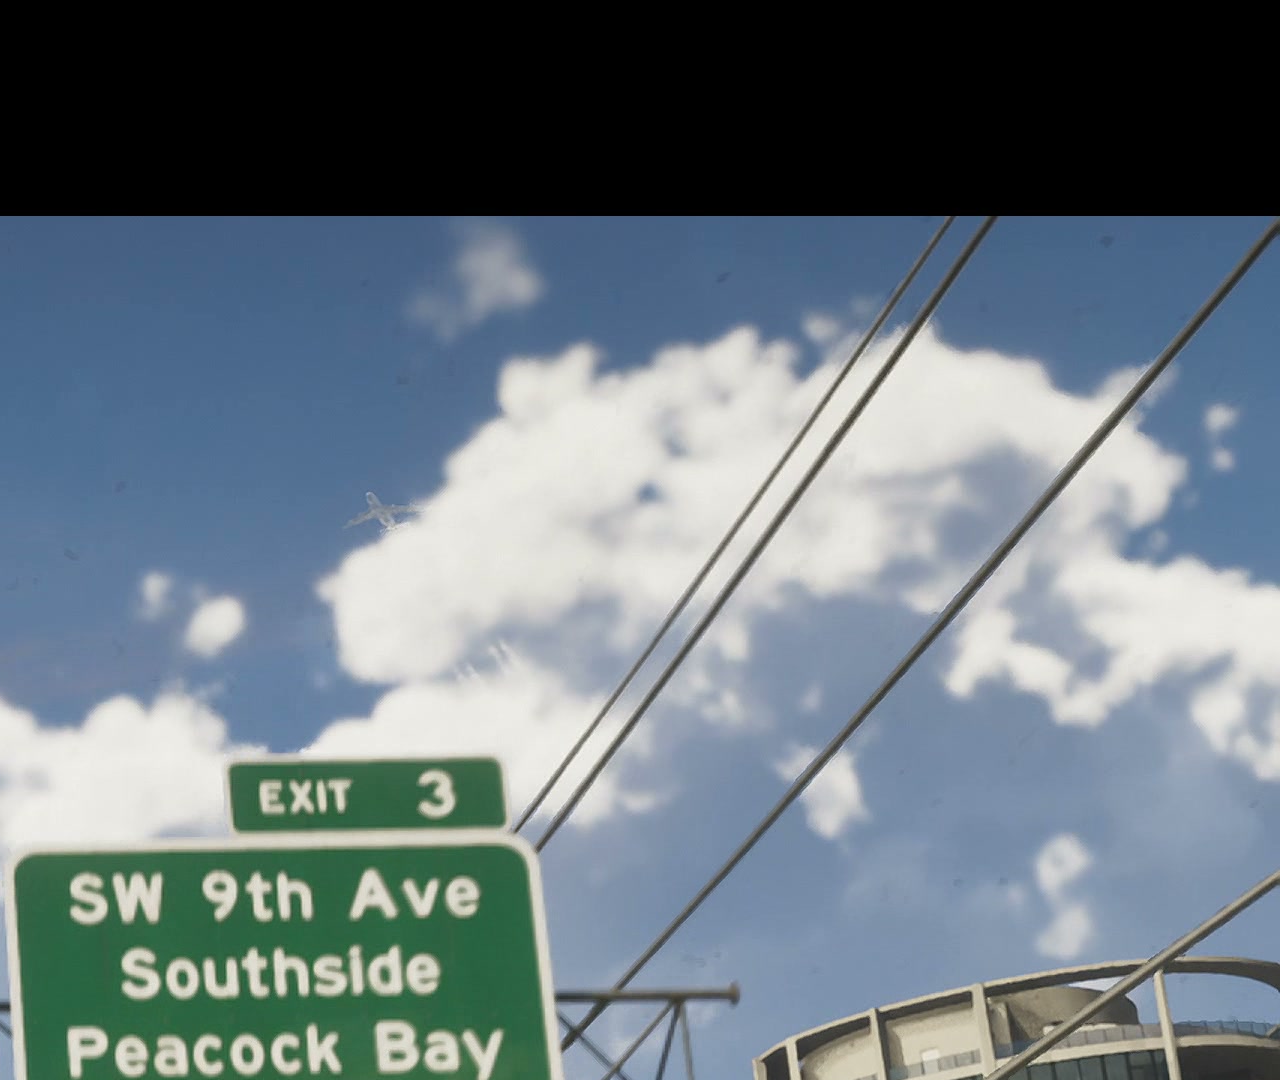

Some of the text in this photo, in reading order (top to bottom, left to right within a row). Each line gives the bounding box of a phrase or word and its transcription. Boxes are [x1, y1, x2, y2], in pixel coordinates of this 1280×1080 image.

[257, 768, 457, 819] EXIT 3
[68, 867, 482, 925] SW 9th Ave
[120, 944, 441, 1001] Southside
[65, 1022, 344, 1080] Peacock
